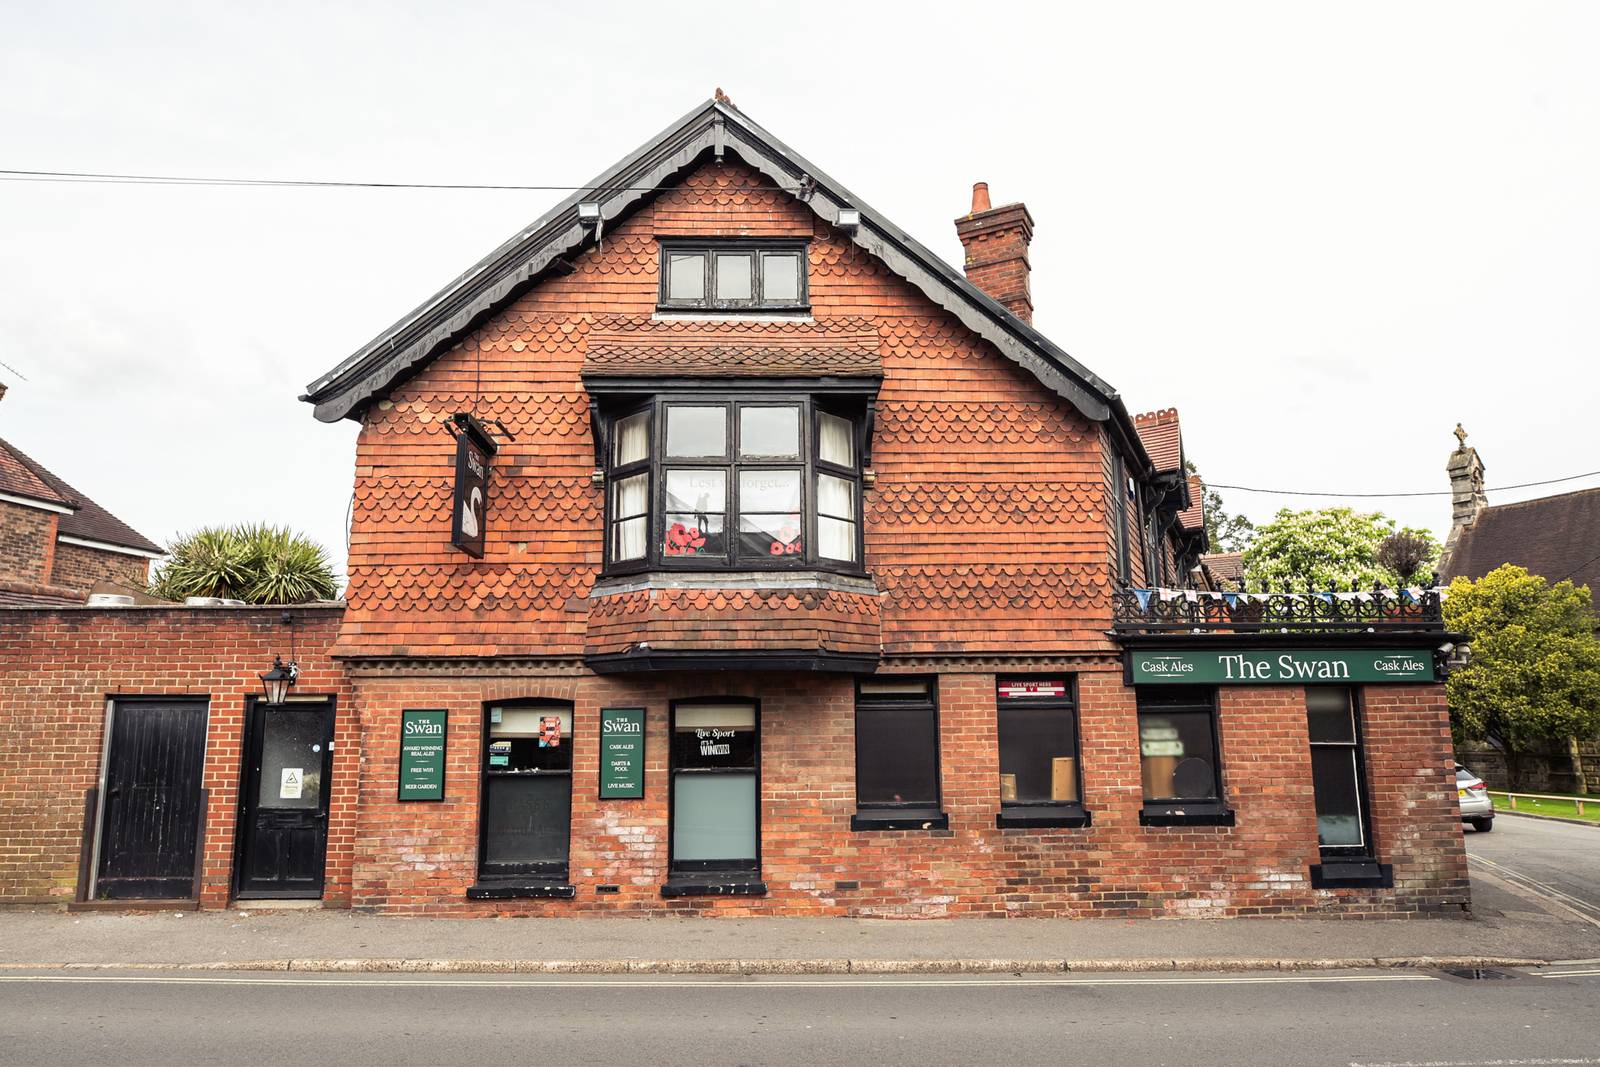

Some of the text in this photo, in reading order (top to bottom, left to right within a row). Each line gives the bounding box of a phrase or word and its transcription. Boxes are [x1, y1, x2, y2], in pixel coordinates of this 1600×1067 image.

[468, 450, 484, 480] Swan
[1141, 661, 1194, 672] Cask Ales
[1218, 654, 1350, 679] The Swan
[1374, 660, 1424, 670] Cask Ales
[406, 721, 442, 734] Swan
[604, 720, 640, 733] Swan
[695, 728, 735, 739] Live Sport
